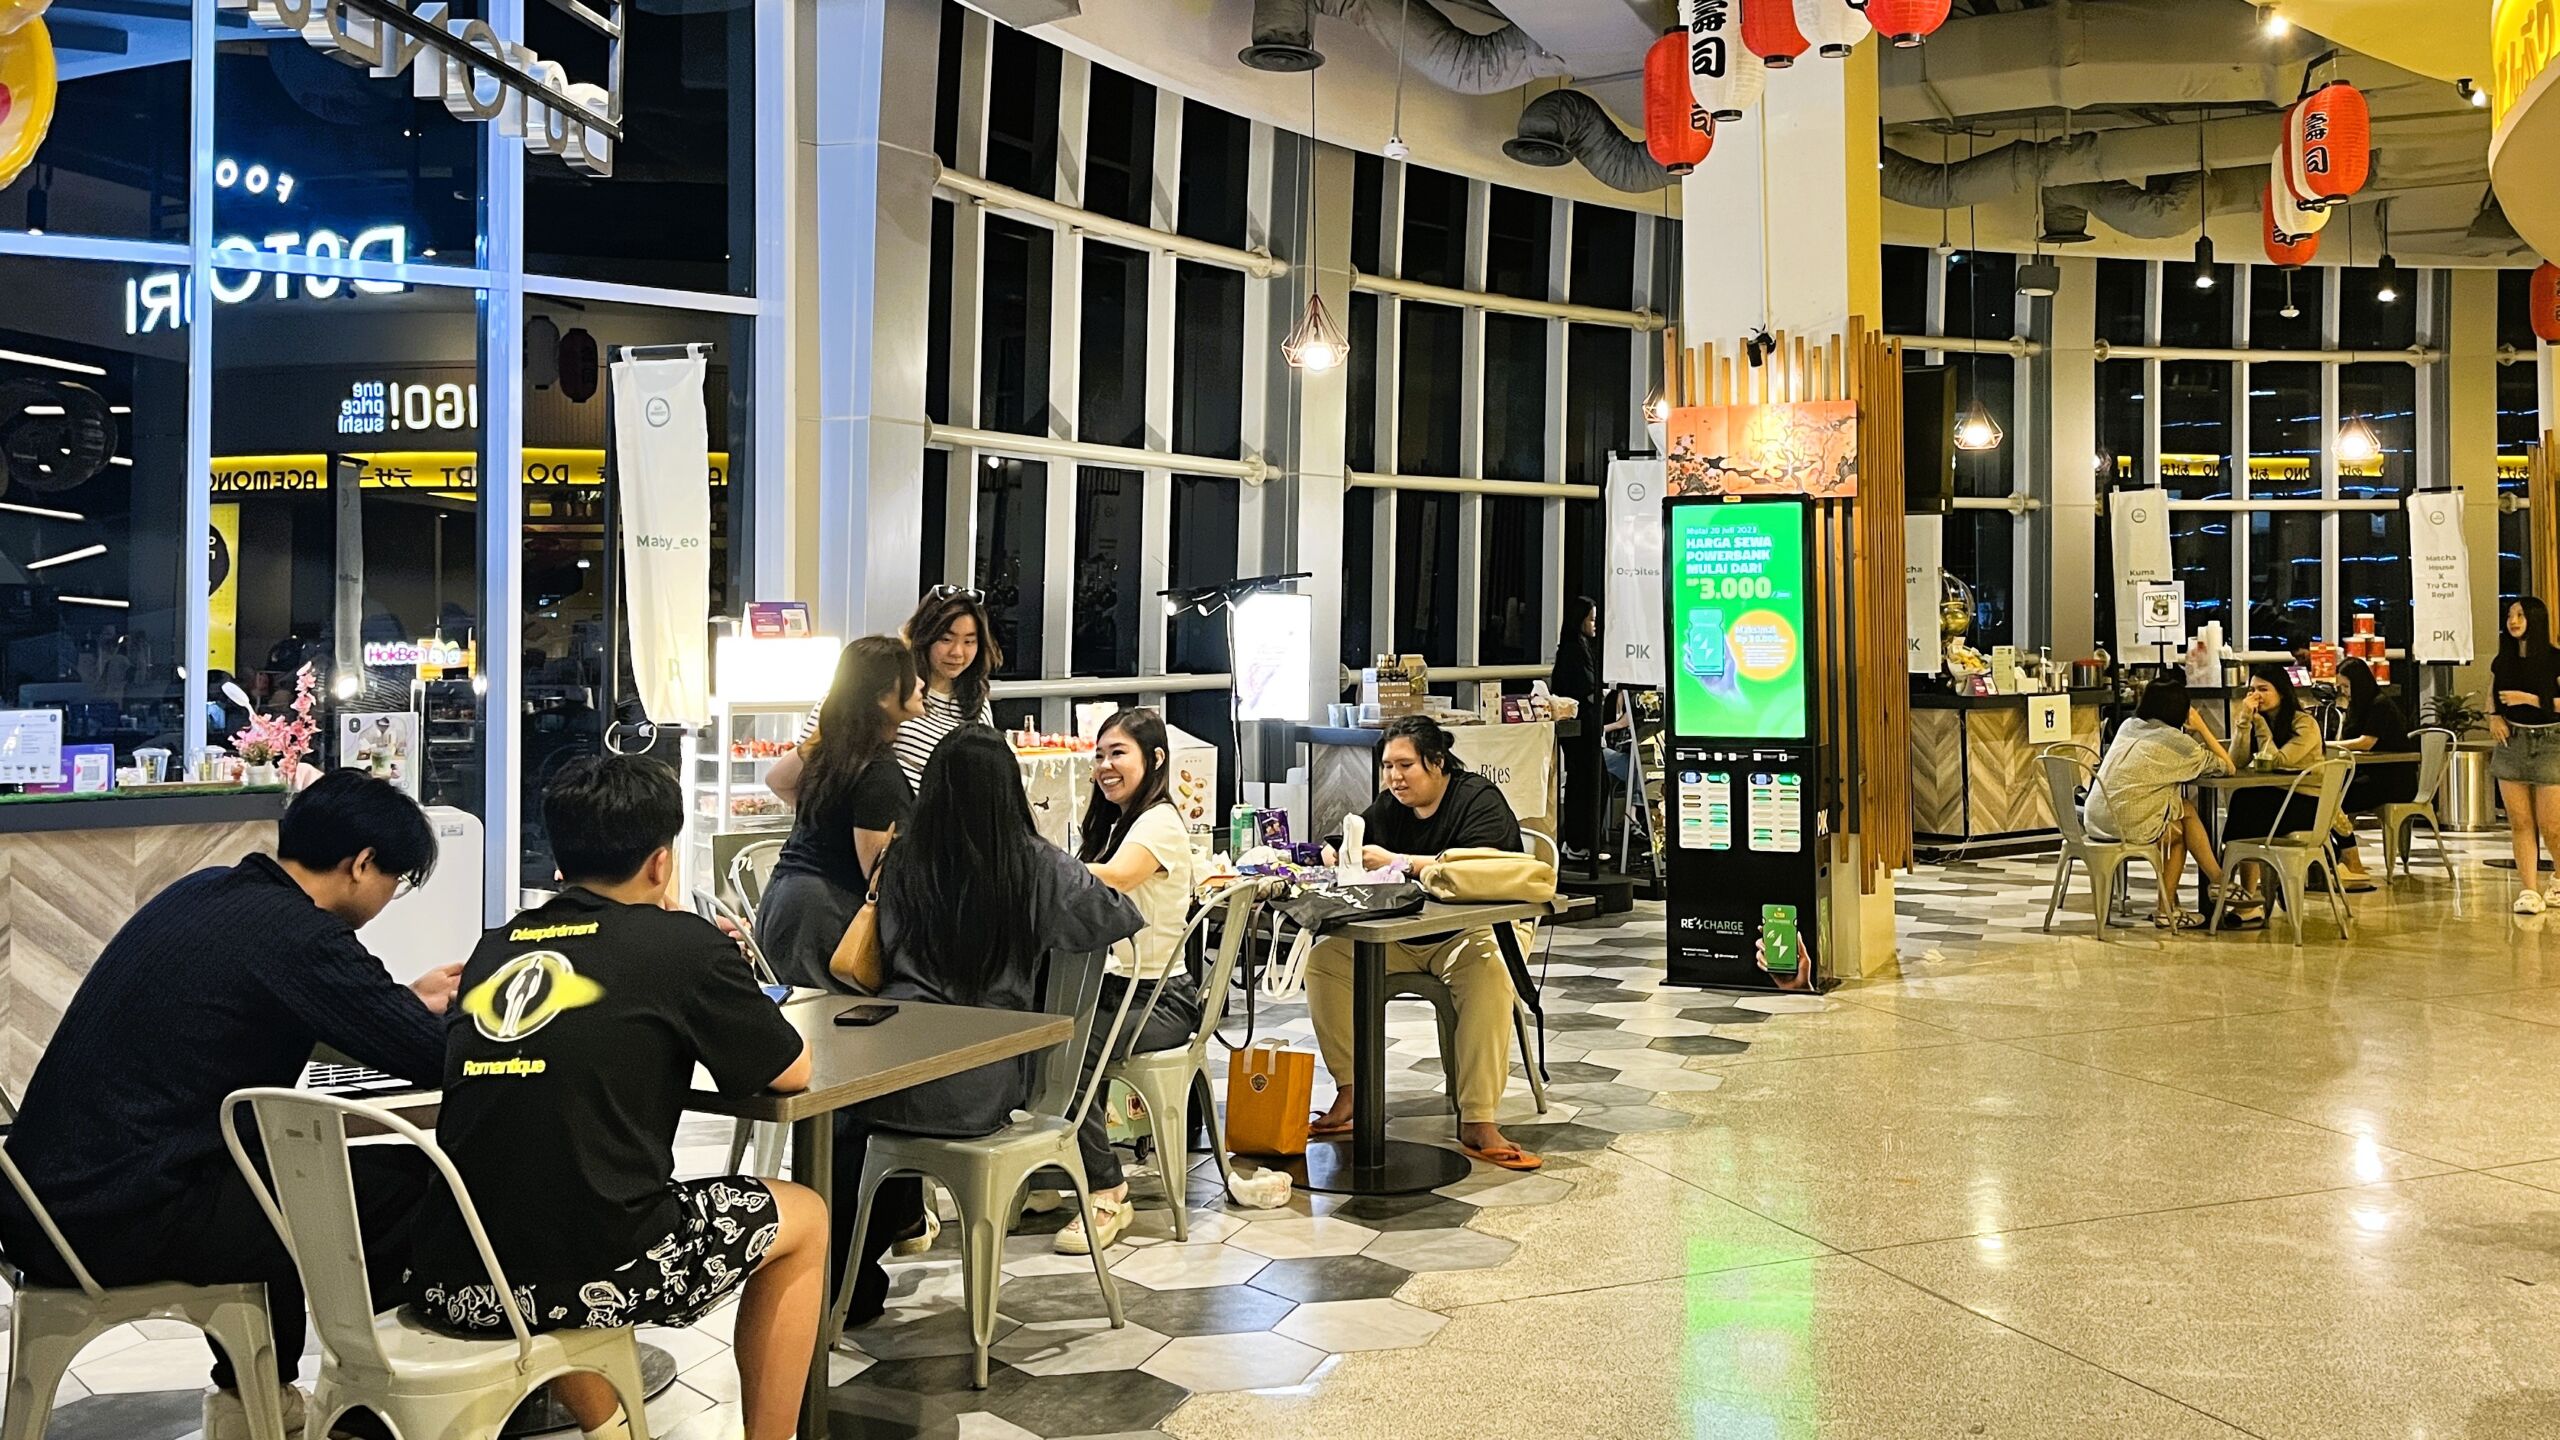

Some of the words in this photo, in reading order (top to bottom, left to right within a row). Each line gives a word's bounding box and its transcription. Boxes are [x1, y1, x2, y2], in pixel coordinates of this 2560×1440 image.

[1686, 537, 1731, 549] HARGA
[1733, 536, 1772, 548] SEWA
[1686, 550, 1770, 562] POWERBANK
[2426, 554, 2457, 562] Matcha
[1686, 563, 1728, 575] MULAI
[1730, 562, 1763, 574] DARI
[1700, 576, 1772, 600] 3.000
[2433, 630, 2456, 642] PIK
[1625, 644, 1650, 660] PIK
[1703, 919, 1744, 931] CHARGE
[463, 1057, 546, 1077] Romantique
